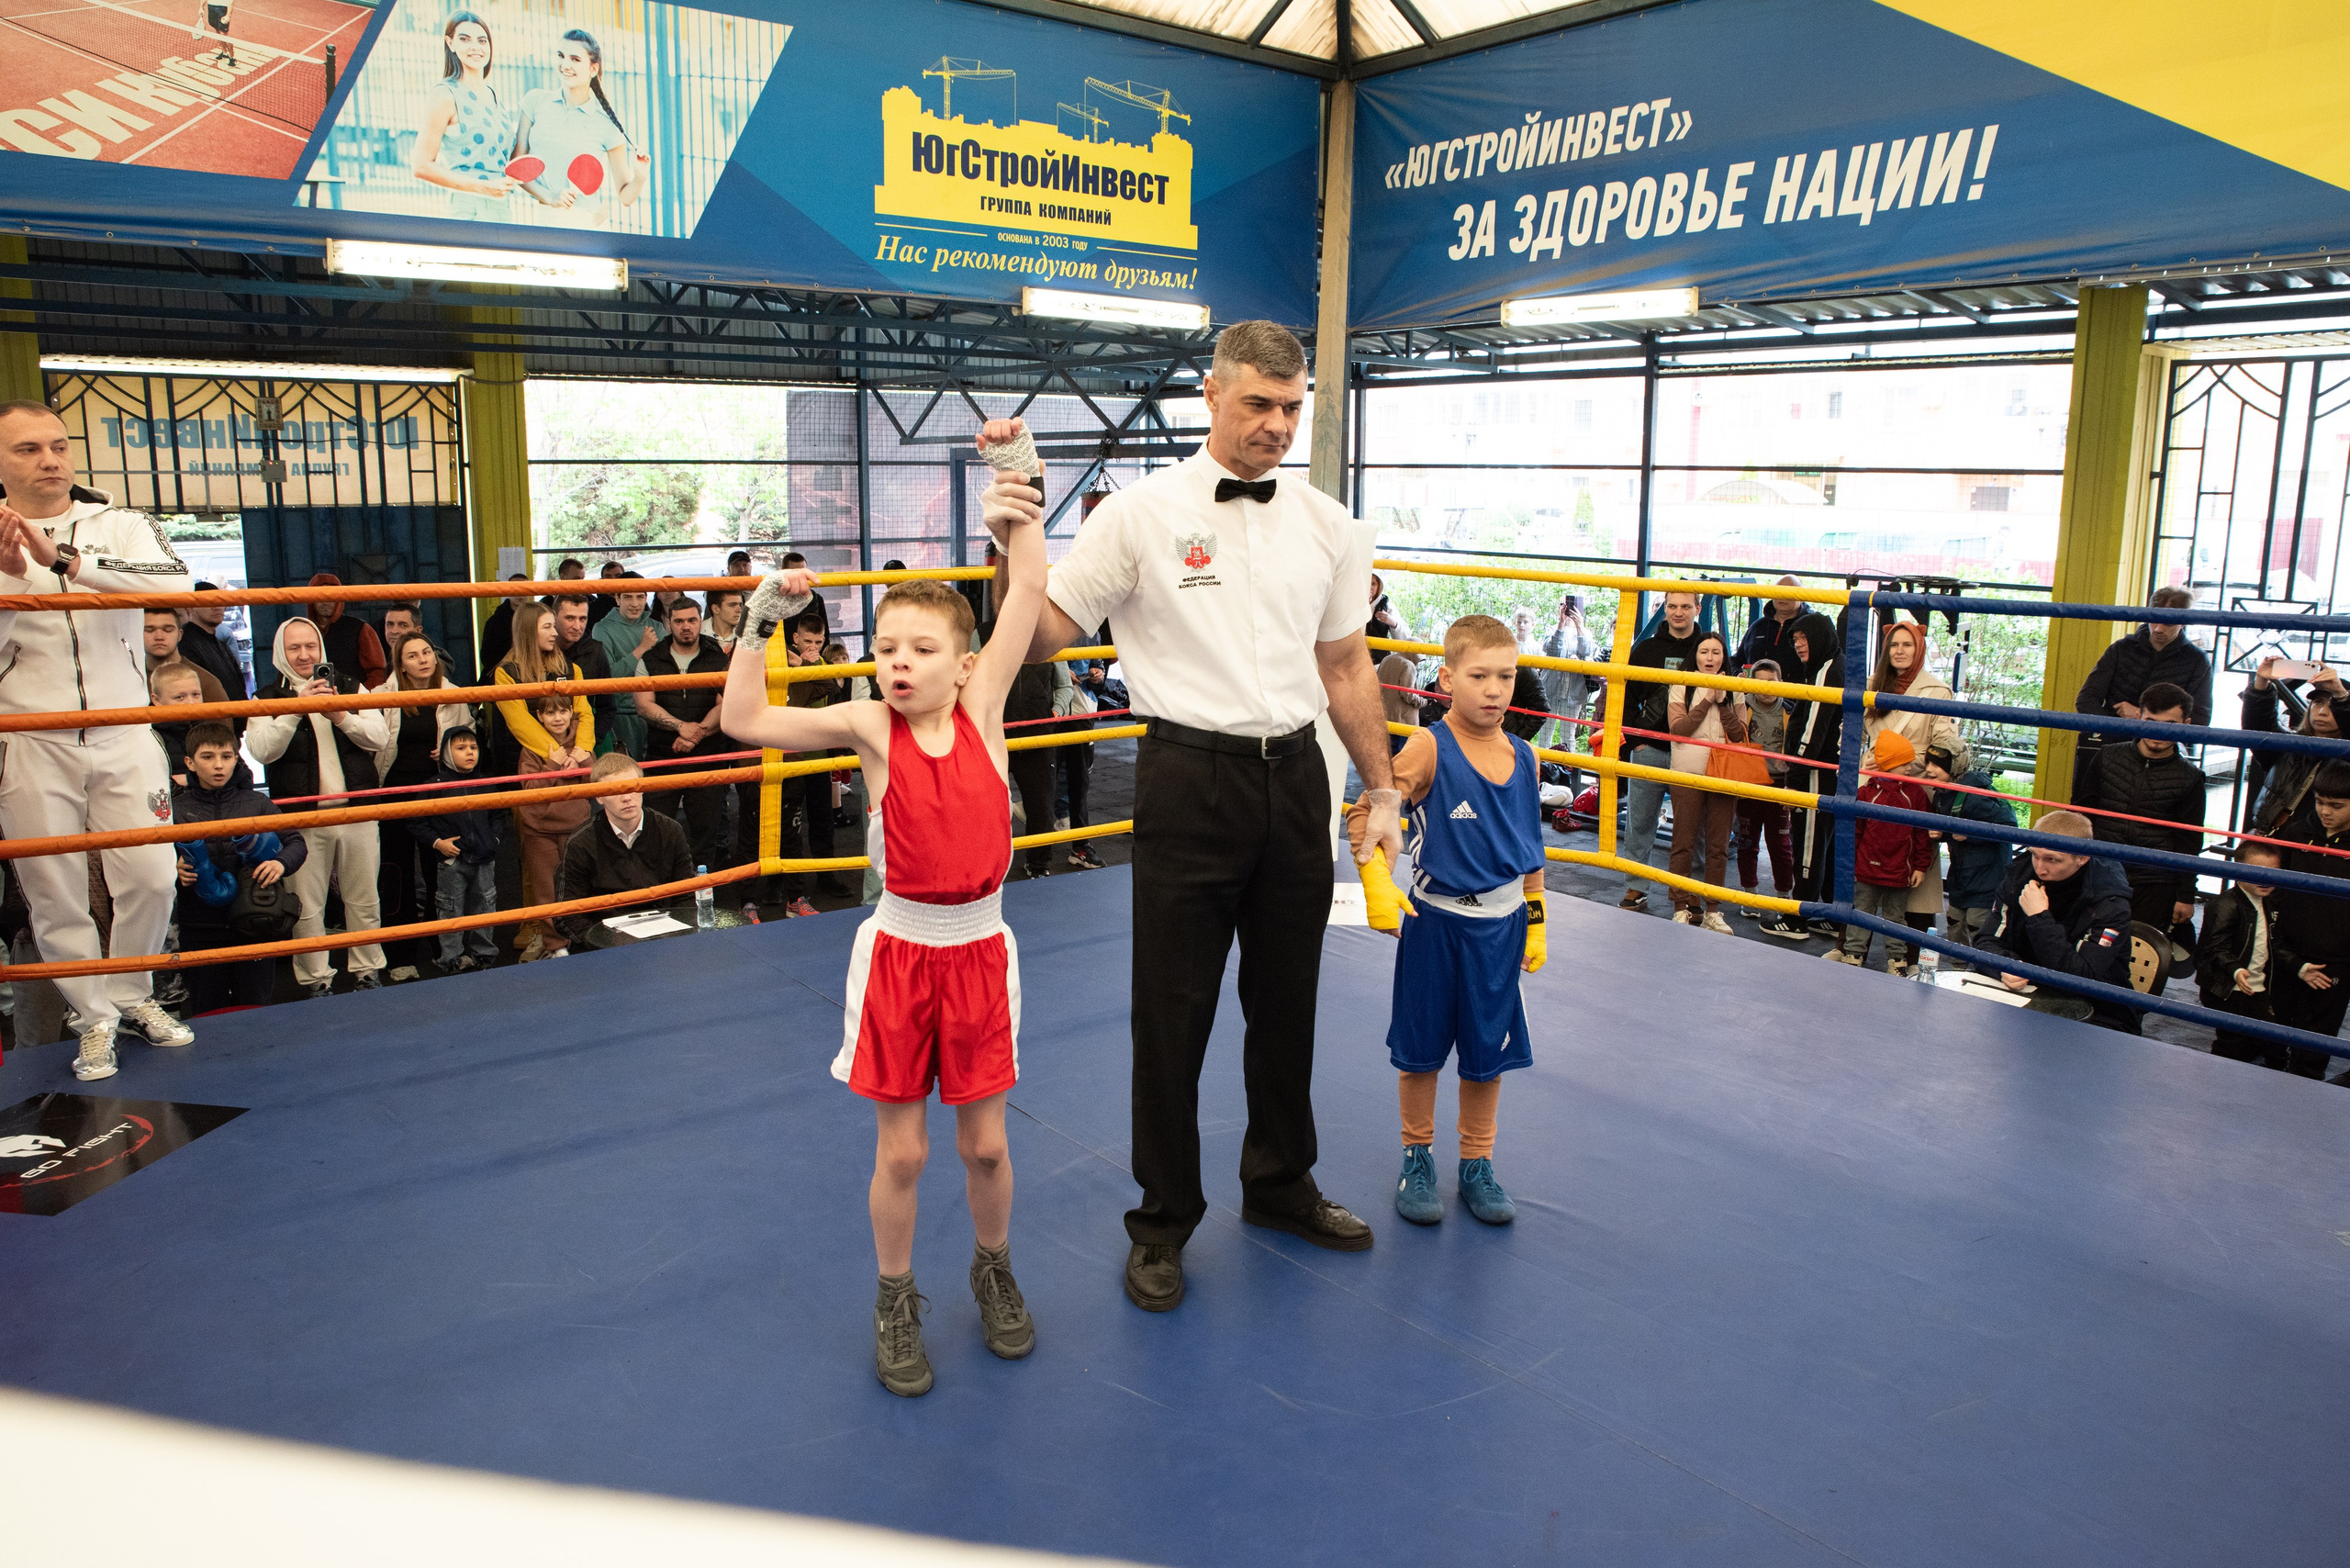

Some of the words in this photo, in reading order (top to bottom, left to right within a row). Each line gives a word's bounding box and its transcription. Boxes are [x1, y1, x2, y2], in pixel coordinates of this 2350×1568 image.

[912, 131, 1170, 205] ЮгСтройИнвест
[1384, 97, 1693, 190] «ЮГСТРОЙИНВЕСТ»
[980, 196, 1032, 217] ГРУППА
[1038, 203, 1112, 226] КОМПАНИЙ
[1448, 200, 1497, 262] ЗА
[1508, 162, 1756, 263] ЗДОРОВЬЕ
[1763, 124, 2000, 227] НАЦИИ!
[875, 234, 927, 264] Нас
[931, 244, 1098, 282] рекомендуют
[1103, 258, 1198, 290] друзьям!
[998, 231, 1033, 245] ОСНОВАНА
[1035, 236, 1040, 245] В
[1042, 234, 1069, 249] 2003
[1071, 241, 1088, 252] ГОДУ
[20, 1159, 62, 1179] GO
[62, 1123, 133, 1158] FIGHT
